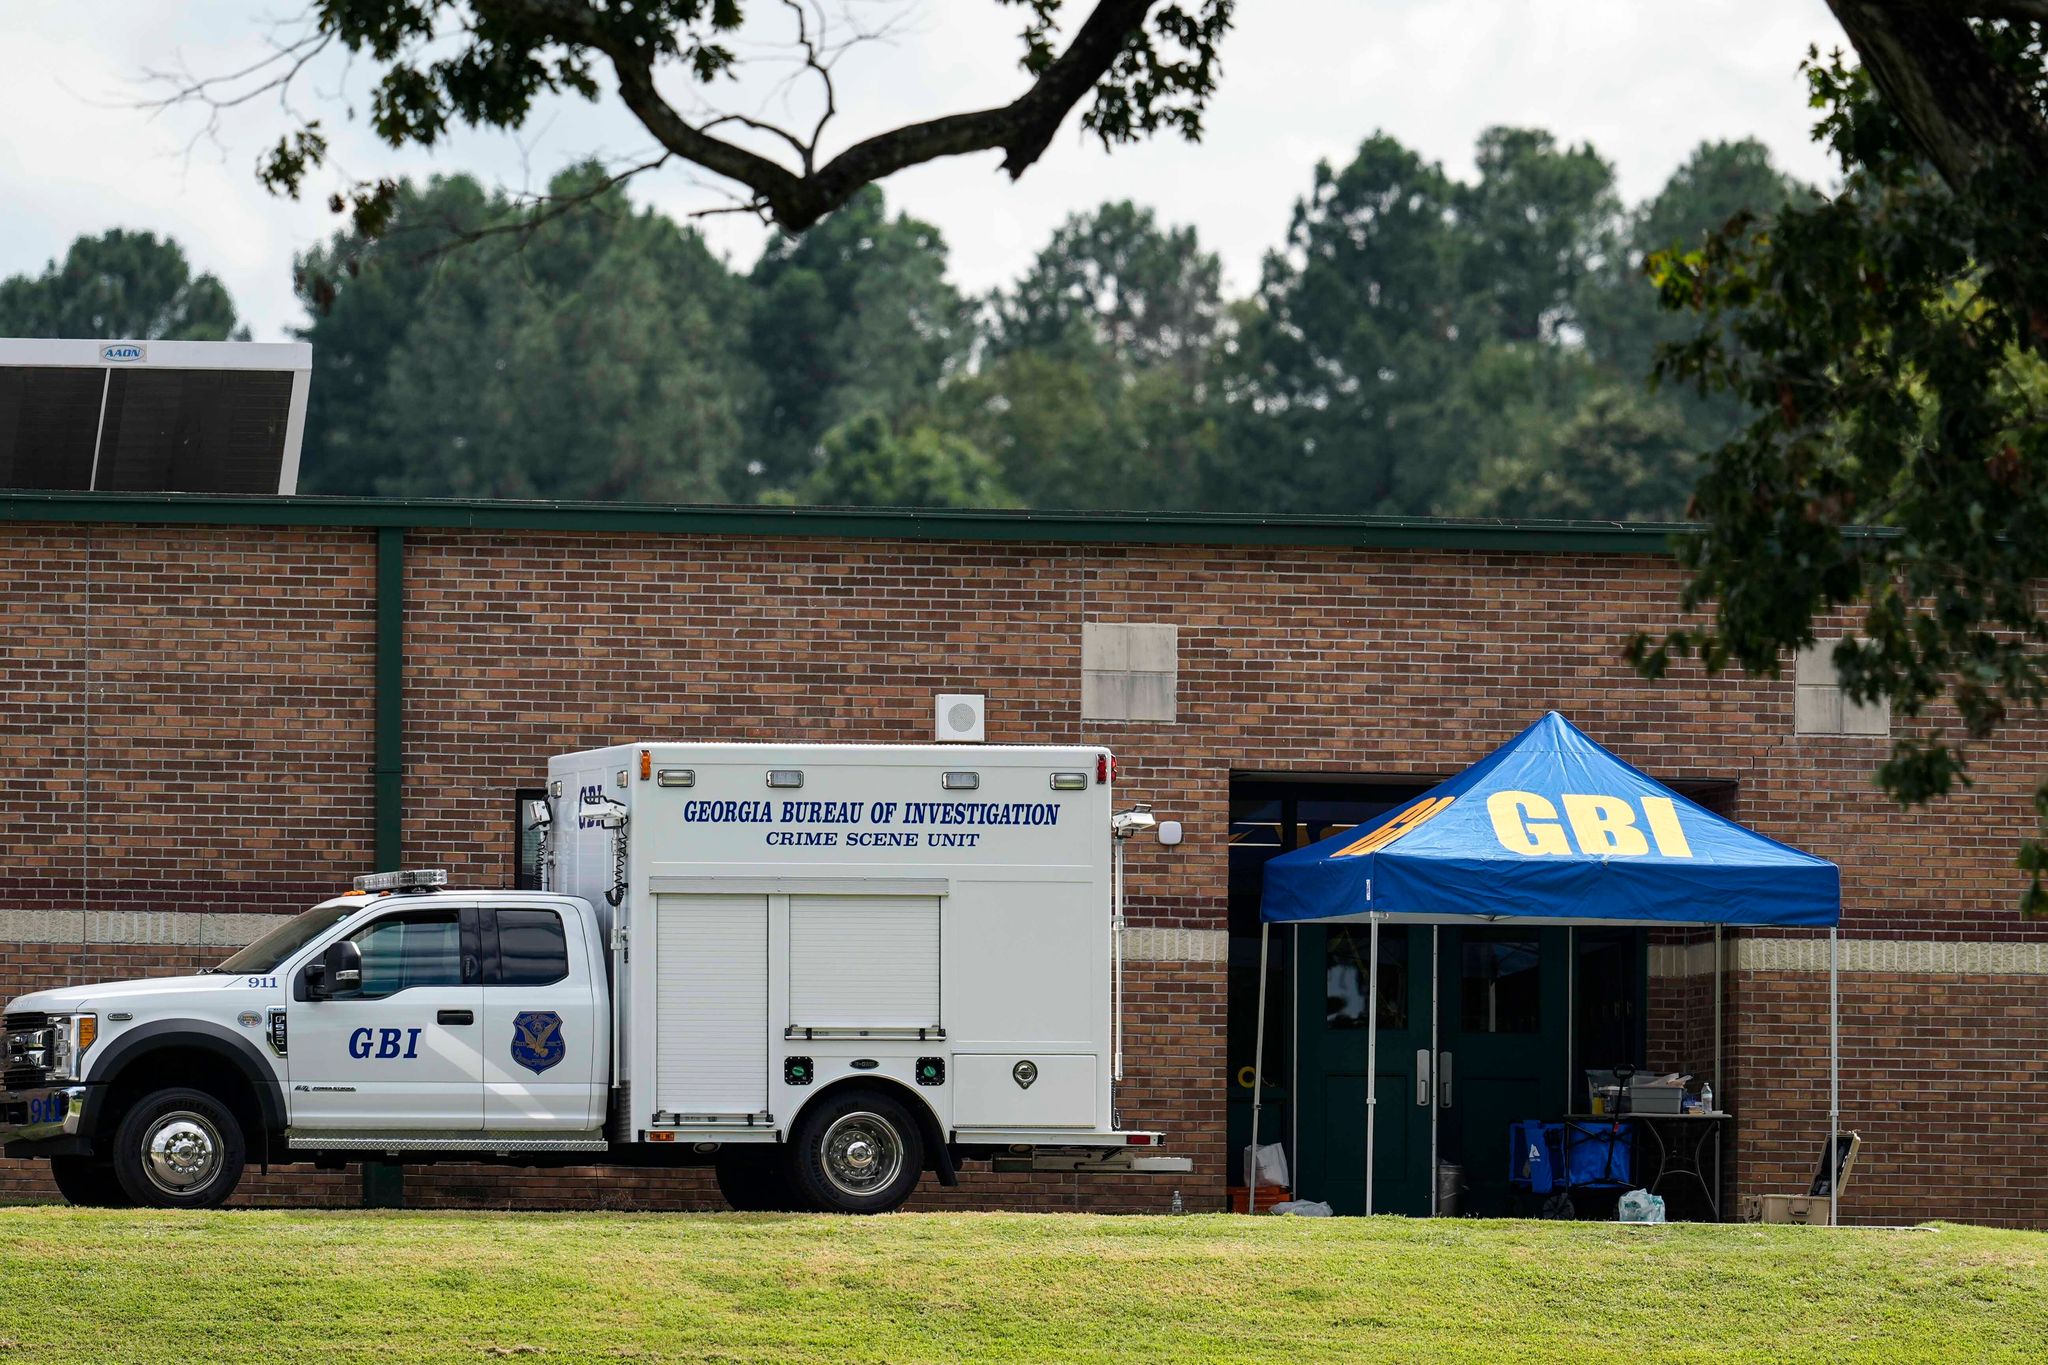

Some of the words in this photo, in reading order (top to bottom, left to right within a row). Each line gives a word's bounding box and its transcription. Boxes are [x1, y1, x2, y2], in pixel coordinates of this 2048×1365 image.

[105, 349, 141, 358] AAON
[684, 800, 772, 823] GEORGIA
[780, 801, 864, 824] BUREAU
[870, 801, 897, 824] OF
[903, 802, 1061, 826] INVESTIGATION
[1486, 790, 1693, 858] GBI
[766, 831, 838, 846] CRIME
[846, 832, 919, 847] SCENE
[927, 833, 980, 847] UNIT
[248, 976, 278, 988] 911
[349, 1027, 422, 1059] GBI
[31, 1097, 63, 1124] 911
